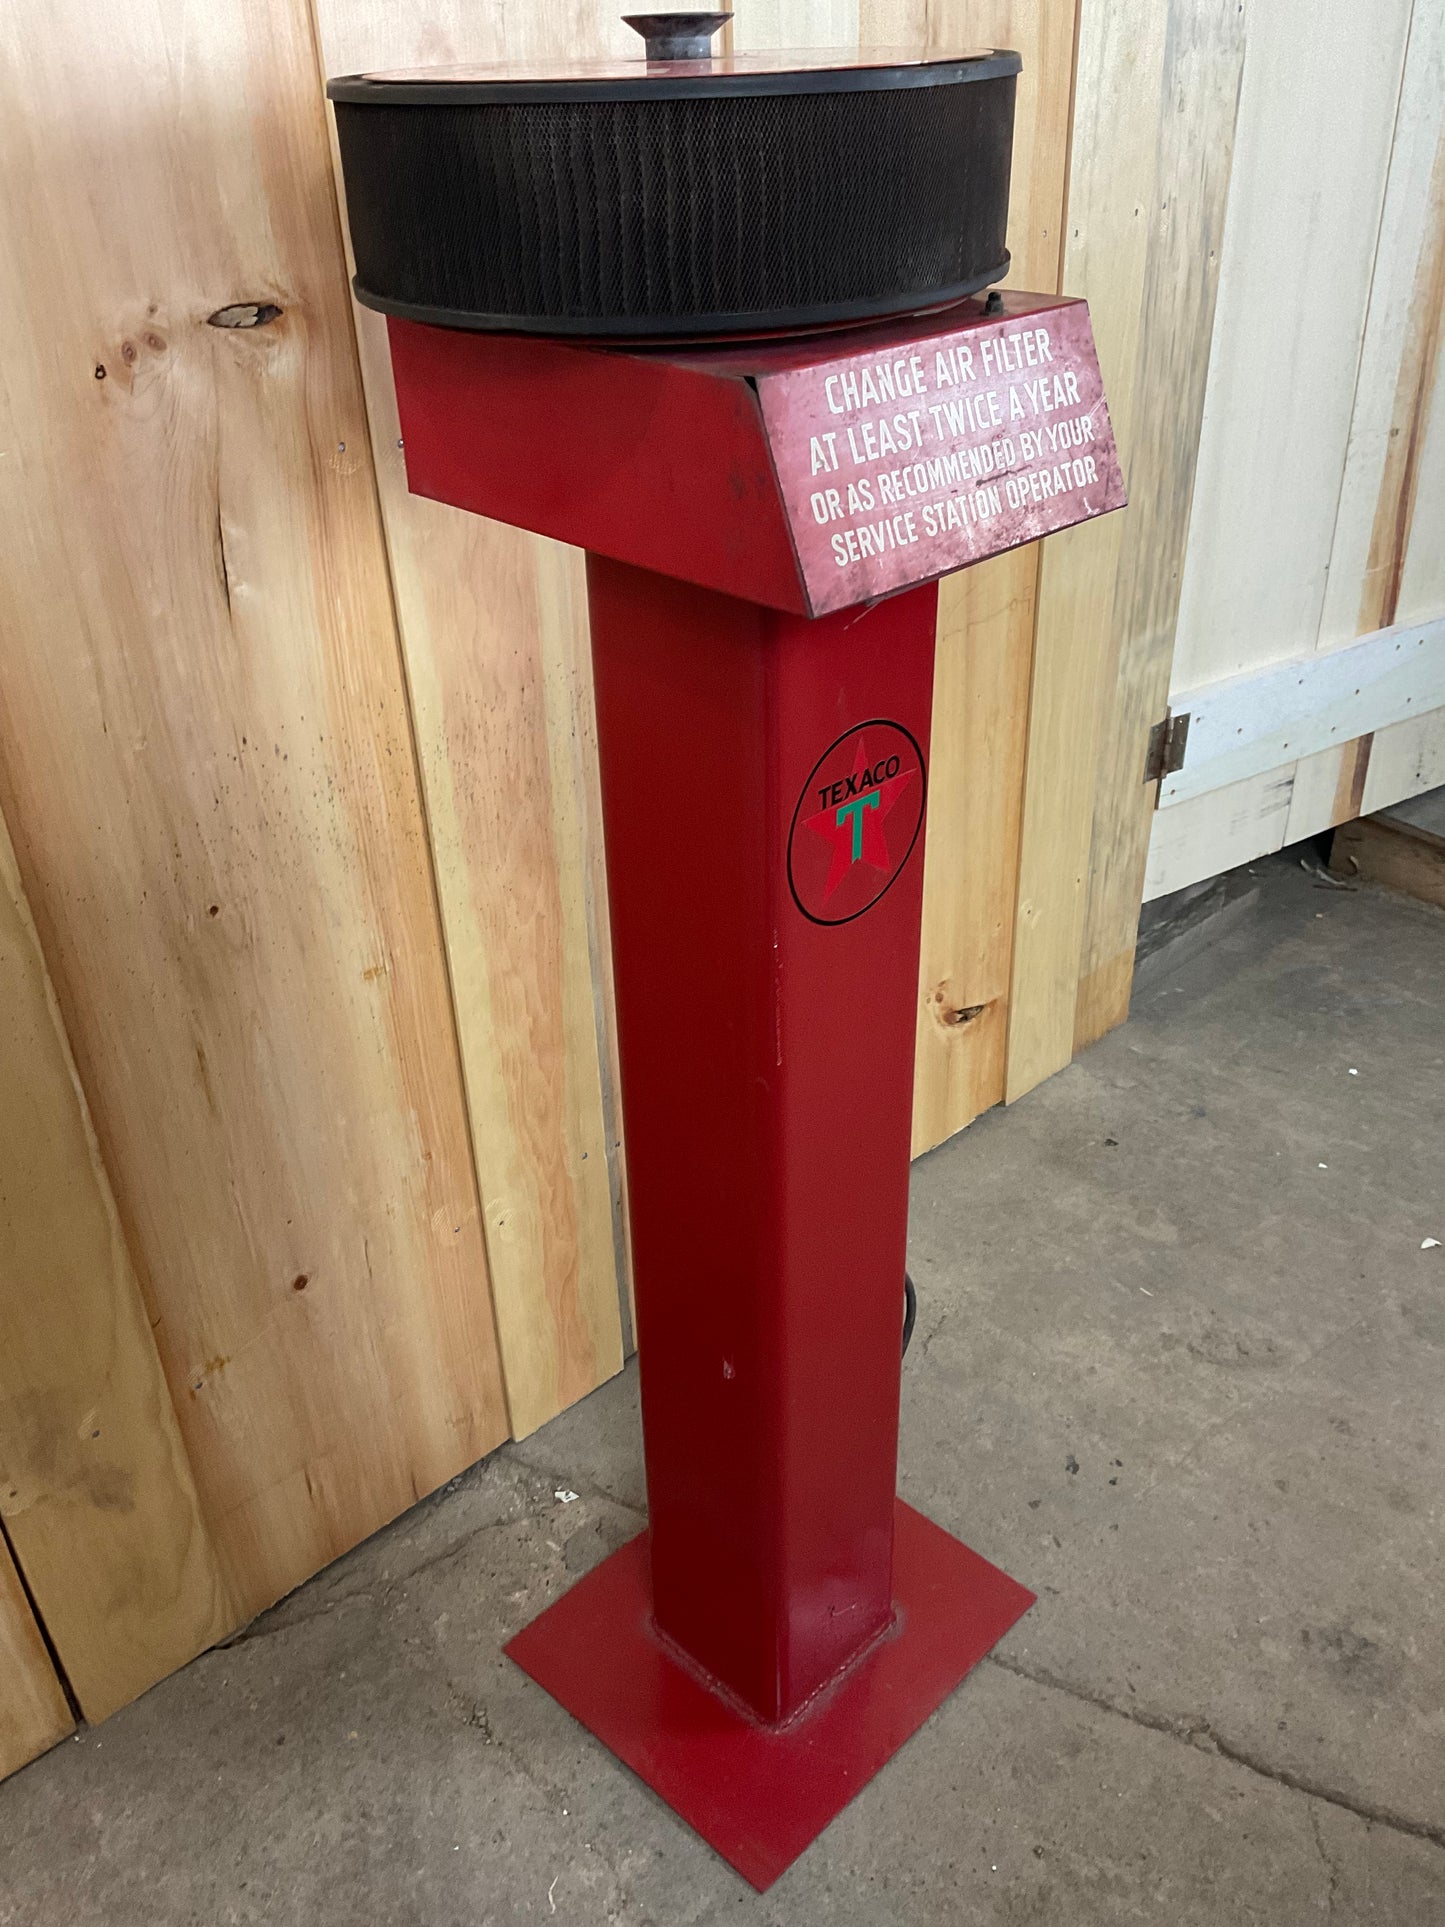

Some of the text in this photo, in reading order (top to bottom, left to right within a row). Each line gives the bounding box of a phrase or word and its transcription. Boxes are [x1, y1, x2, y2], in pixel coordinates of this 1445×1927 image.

[825, 328, 1053, 414] CHANGE AIR FILTER
[809, 371, 1081, 476] AT LEAST TWICE A YEAR
[811, 416, 1096, 524] OR AS RECOMMENDED BY YOUR
[831, 455, 1099, 567] SERVICE STATION OPERATOR
[818, 755, 900, 810] TEXACO
[836, 789, 880, 864] T
